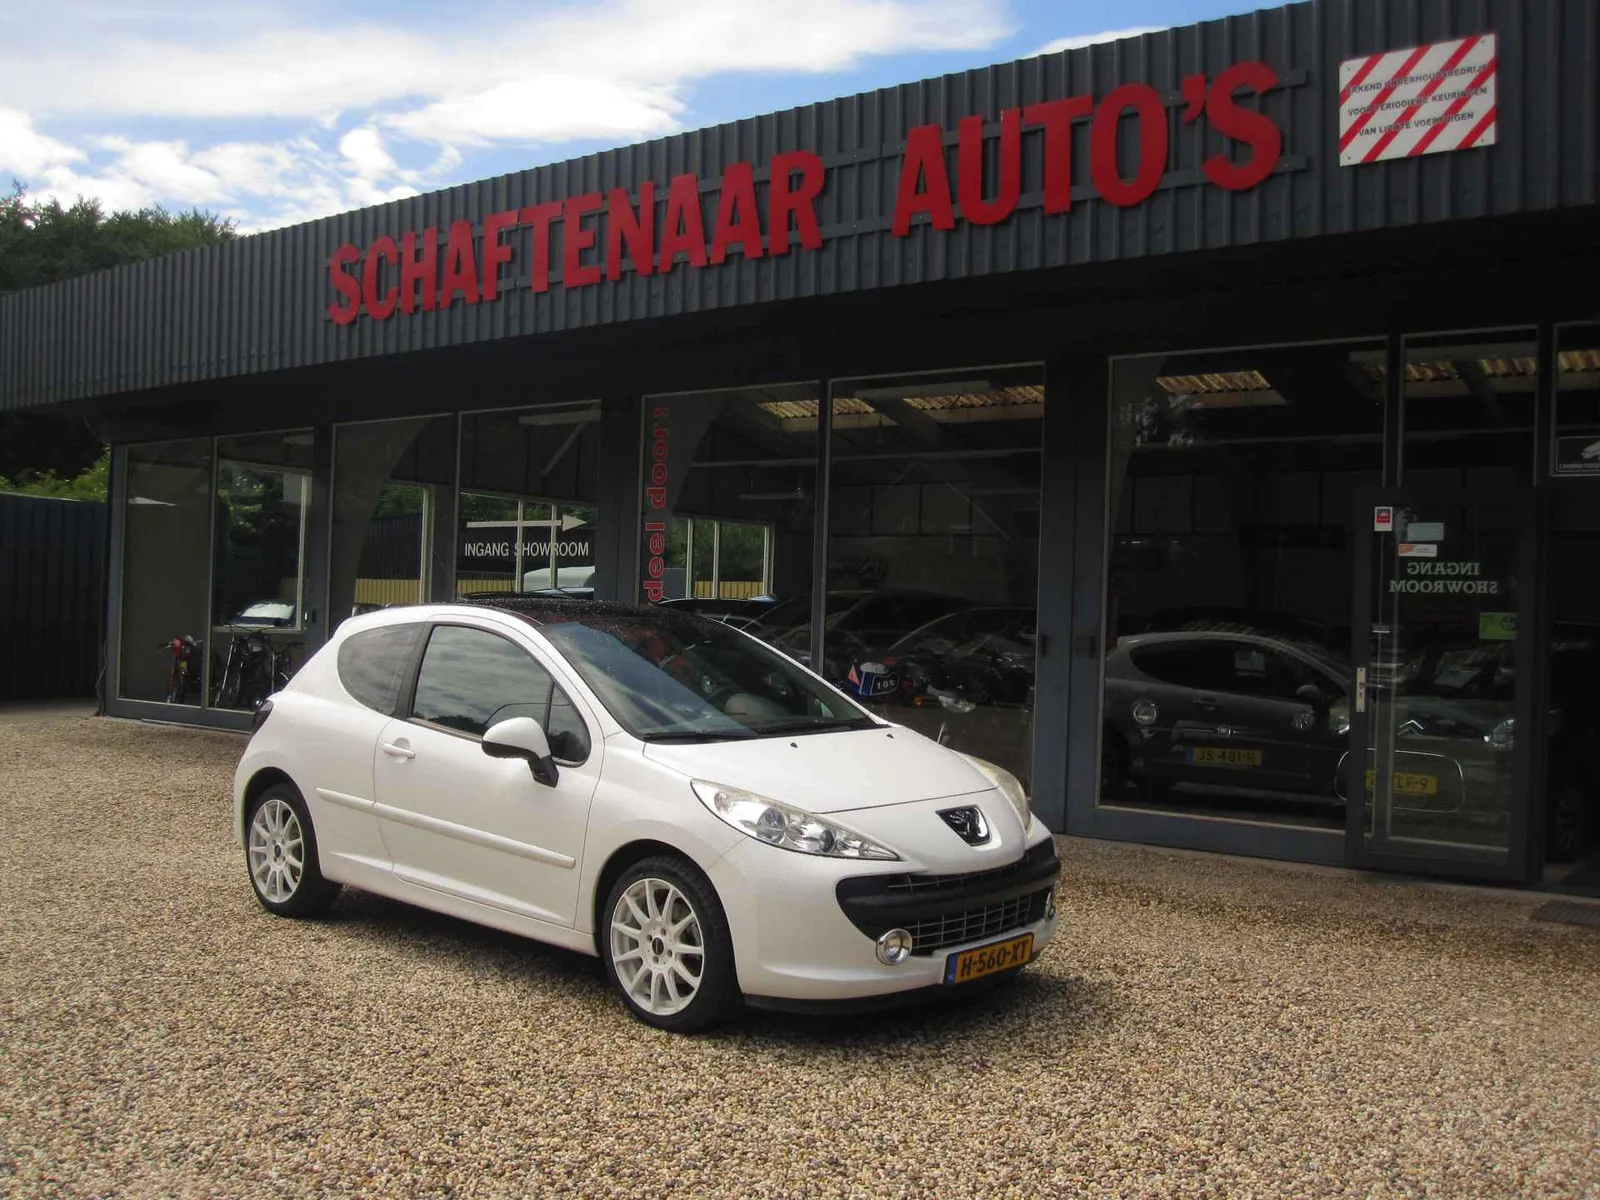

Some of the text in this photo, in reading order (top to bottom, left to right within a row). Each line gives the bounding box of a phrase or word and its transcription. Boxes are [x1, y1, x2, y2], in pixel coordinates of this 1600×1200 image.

[1432, 87, 1487, 103] KEURINGEN
[1360, 126, 1377, 136] VAN
[329, 60, 1282, 325] SCHAFTENAAR AUTO'S
[464, 541, 589, 557] INGANG SHOWROOM
[960, 941, 1029, 978] H-560-XT
